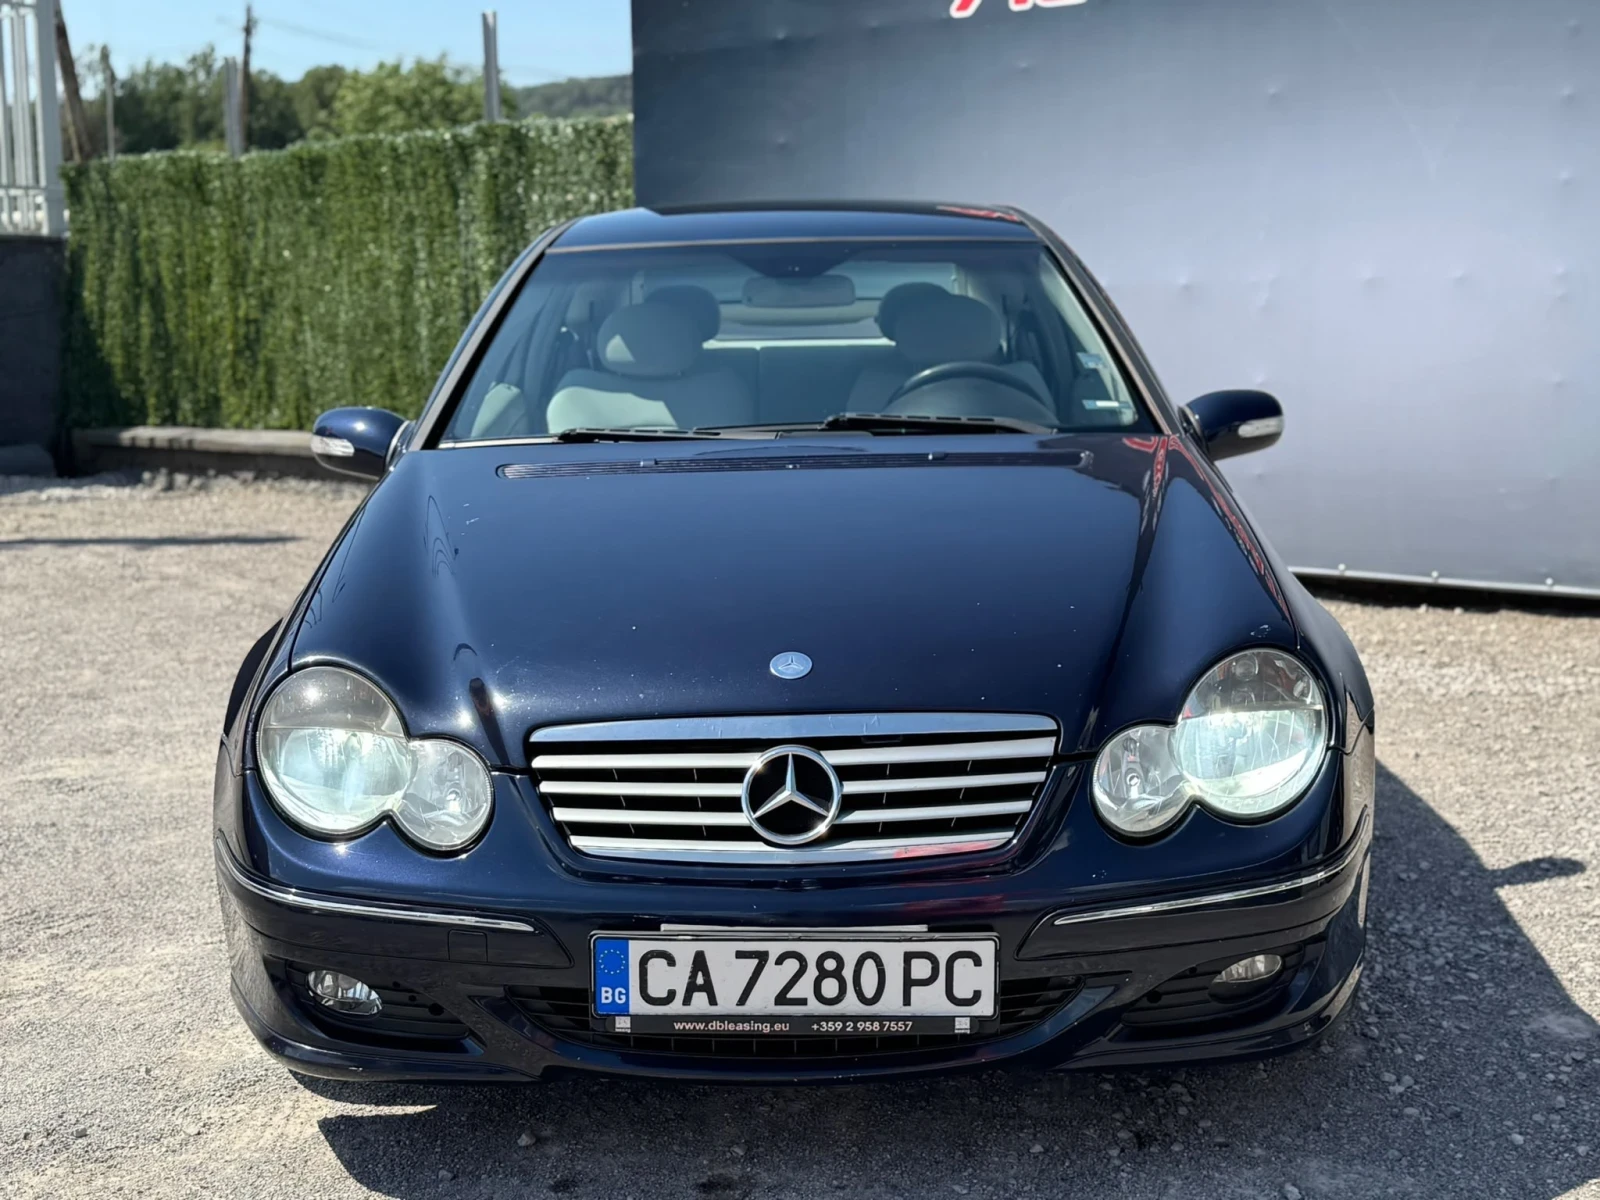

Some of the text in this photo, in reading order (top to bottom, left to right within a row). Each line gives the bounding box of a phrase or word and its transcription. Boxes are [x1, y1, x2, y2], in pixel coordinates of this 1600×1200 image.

[638, 949, 983, 1007] CA 7280 PC
[600, 986, 627, 1004] BG
[673, 1020, 790, 1033] www.dbleasing.eu
[811, 1021, 913, 1032] +359 2 958 7557
